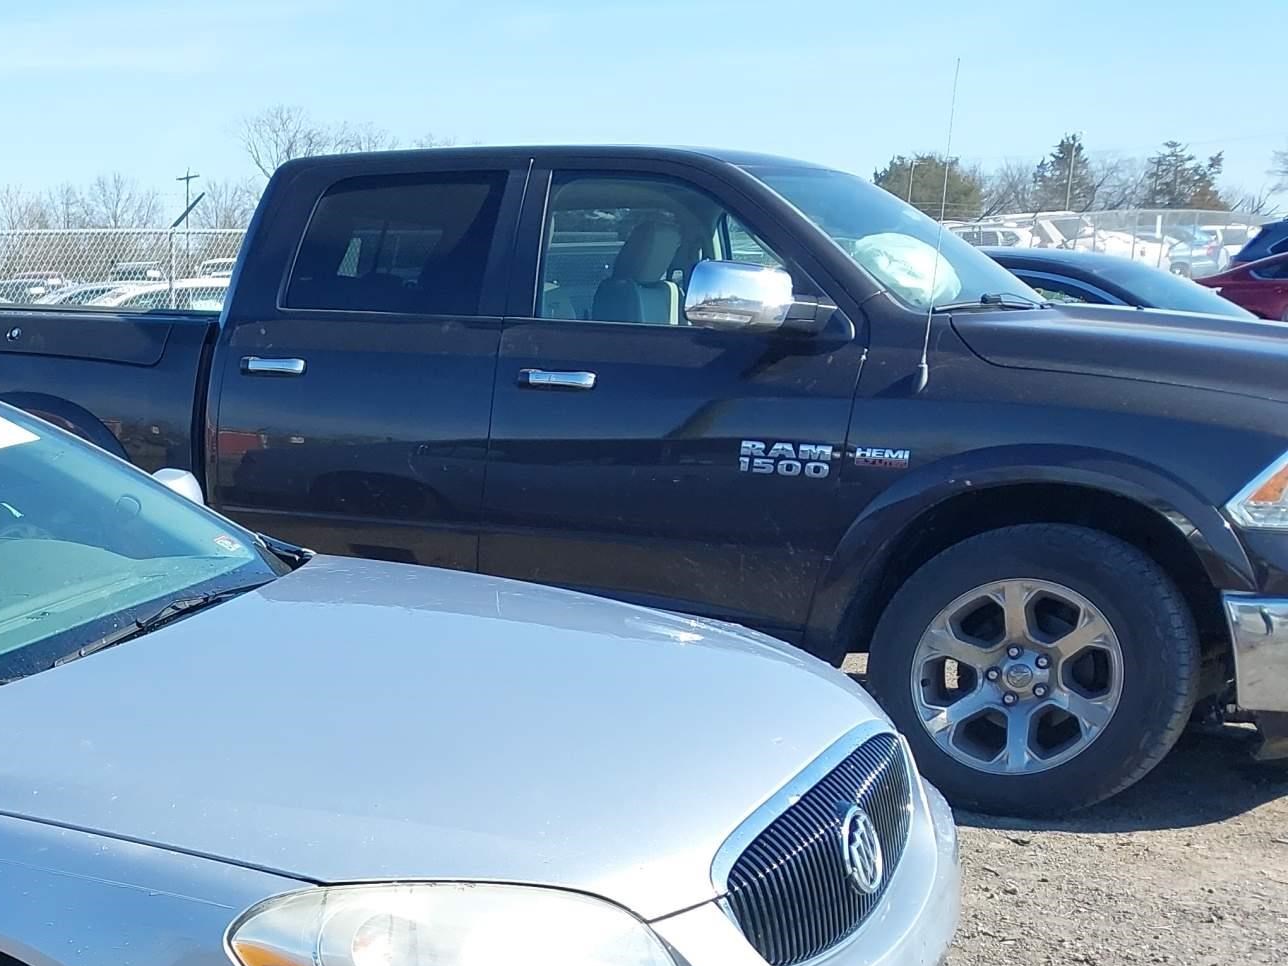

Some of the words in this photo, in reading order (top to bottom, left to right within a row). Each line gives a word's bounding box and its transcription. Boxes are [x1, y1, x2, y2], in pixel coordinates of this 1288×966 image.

[740, 440, 833, 461] RAM
[855, 447, 910, 460] HEMI
[738, 457, 830, 479] 1500
